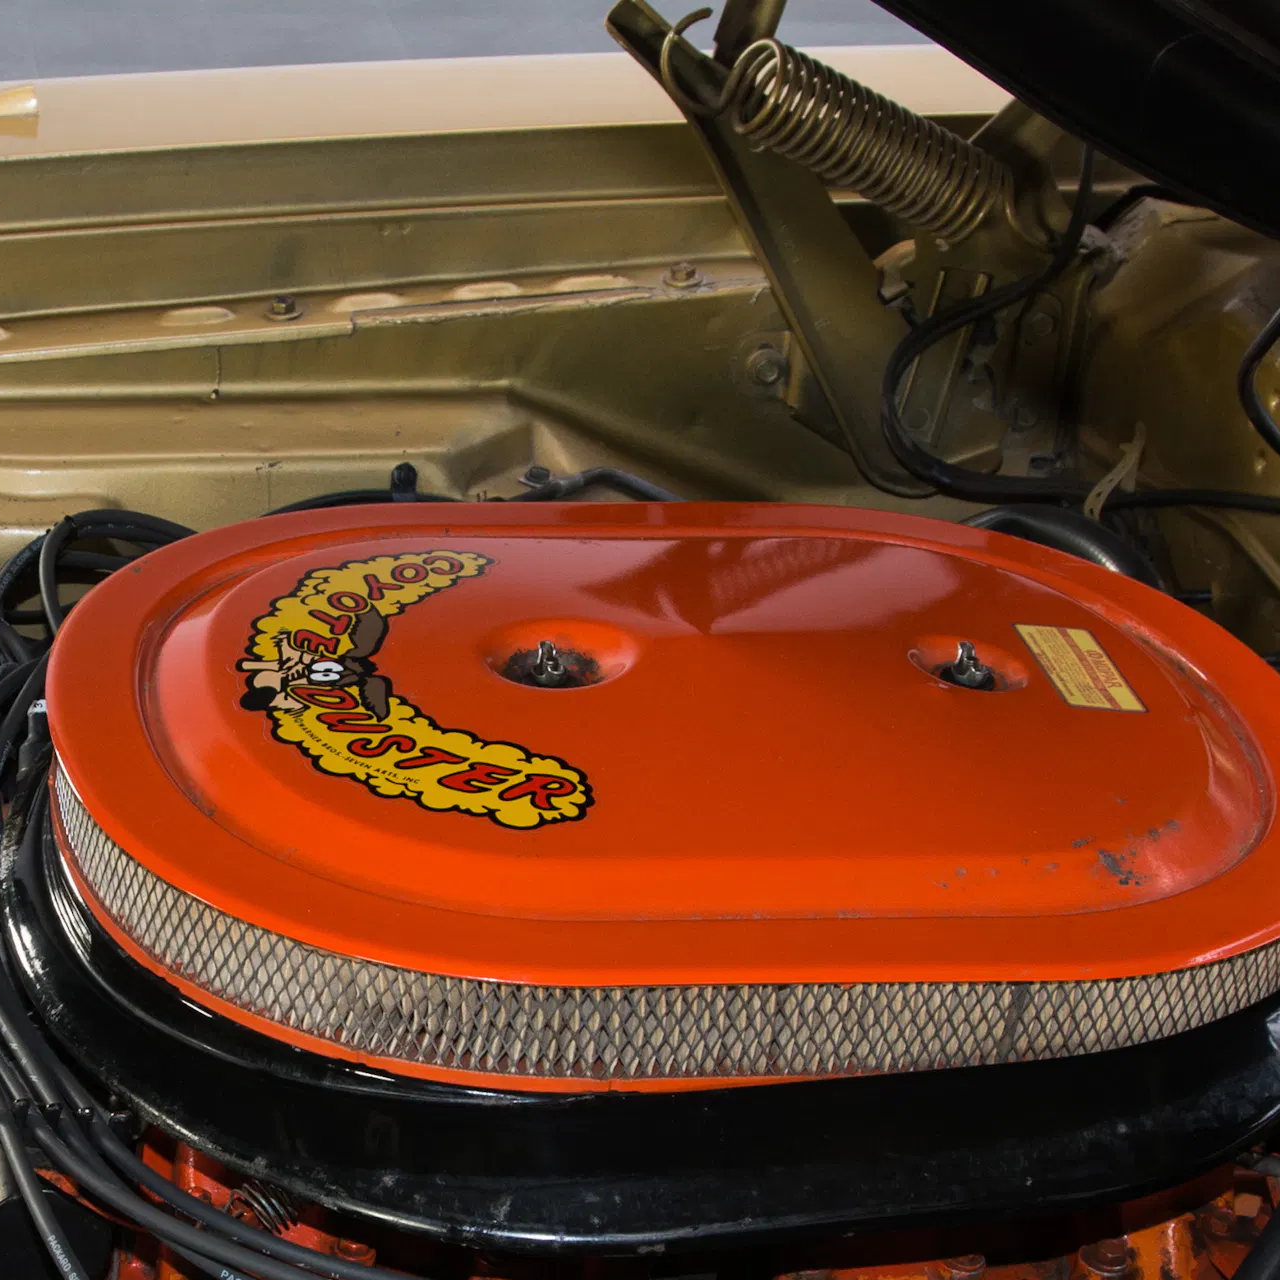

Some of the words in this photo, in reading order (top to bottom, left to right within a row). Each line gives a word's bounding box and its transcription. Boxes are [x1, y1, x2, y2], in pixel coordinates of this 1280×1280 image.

[290, 555, 464, 656] COYOTE
[289, 685, 577, 811] DUSTER
[46, 1234, 72, 1274] PACKARD
